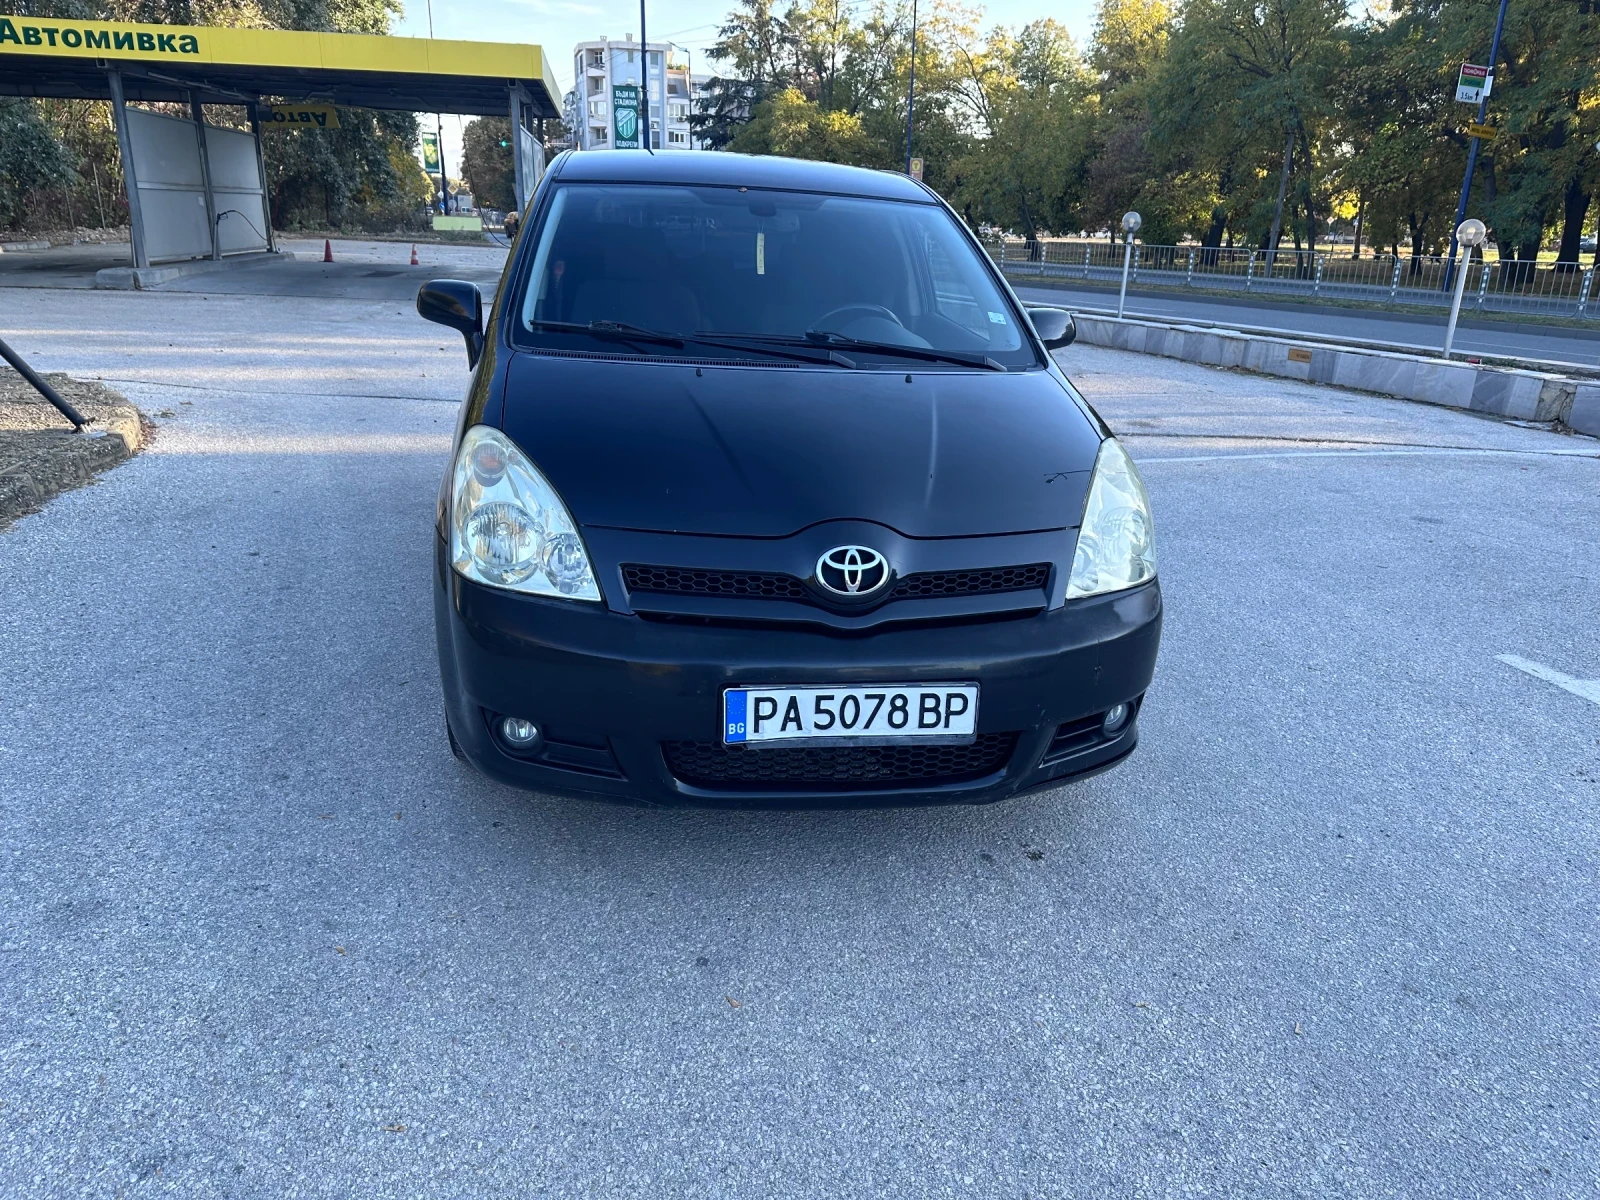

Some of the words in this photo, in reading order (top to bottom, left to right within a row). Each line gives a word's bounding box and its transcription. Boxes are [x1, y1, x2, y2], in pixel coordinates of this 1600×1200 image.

[0, 17, 200, 54] Автомивка
[728, 722, 745, 735] BG
[753, 695, 803, 734] PA
[813, 693, 909, 731] 5078
[917, 692, 969, 730] BP
